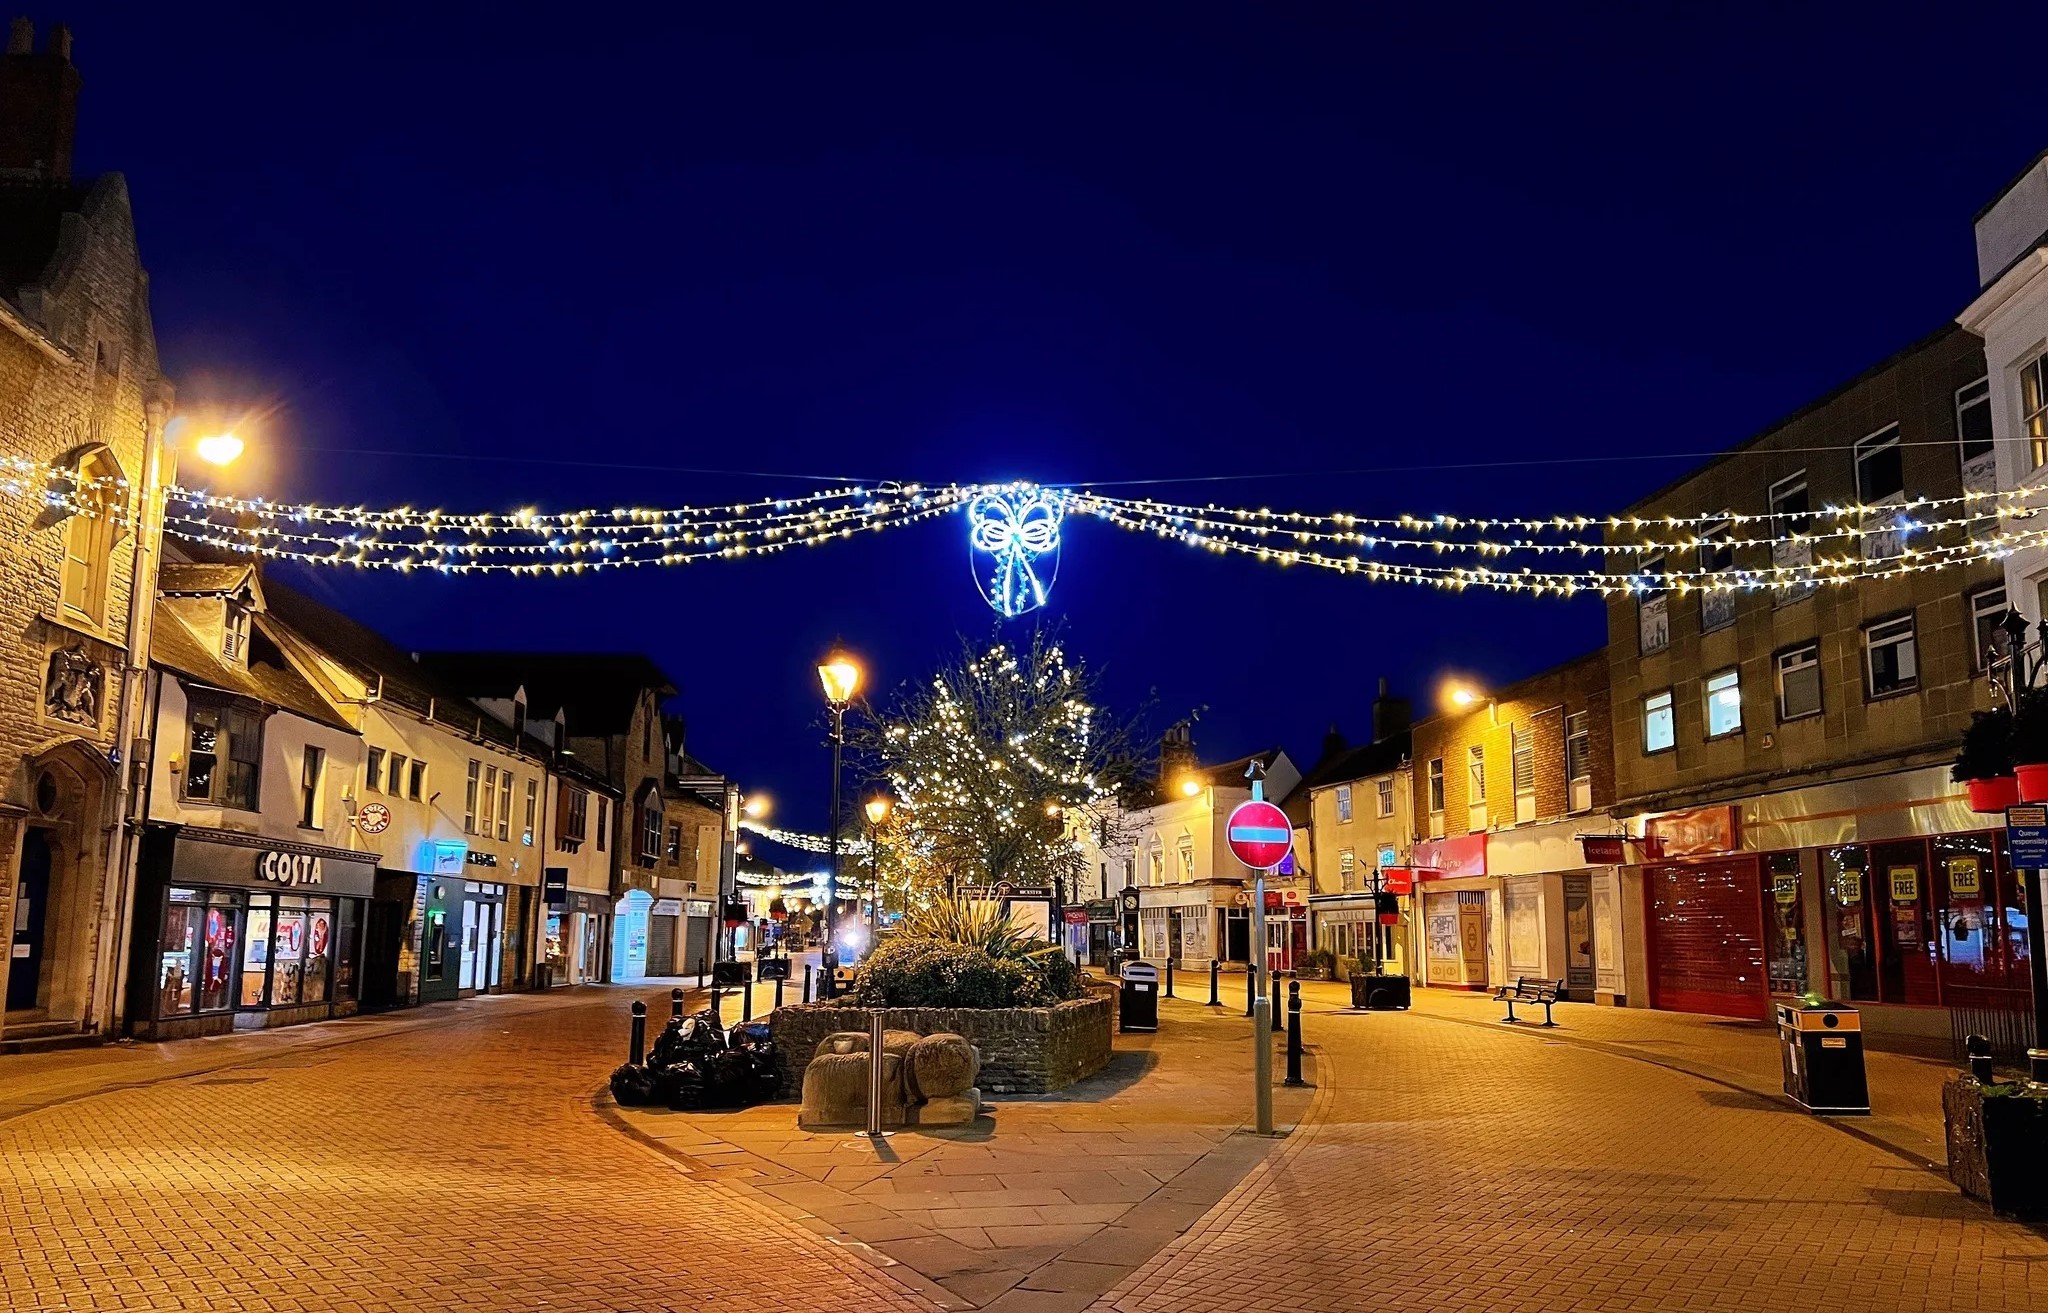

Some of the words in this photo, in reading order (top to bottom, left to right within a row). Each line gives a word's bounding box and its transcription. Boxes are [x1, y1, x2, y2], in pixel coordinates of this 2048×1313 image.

[2018, 829, 2040, 837] Queue
[2011, 838, 2048, 846] responsibly
[1588, 846, 1621, 856] Iceland
[264, 851, 322, 887] COSTA
[1775, 878, 1795, 892] FREE
[1953, 872, 1976, 887] FREE
[1894, 880, 1915, 895] FREE
[1336, 910, 1365, 921] AMICI
